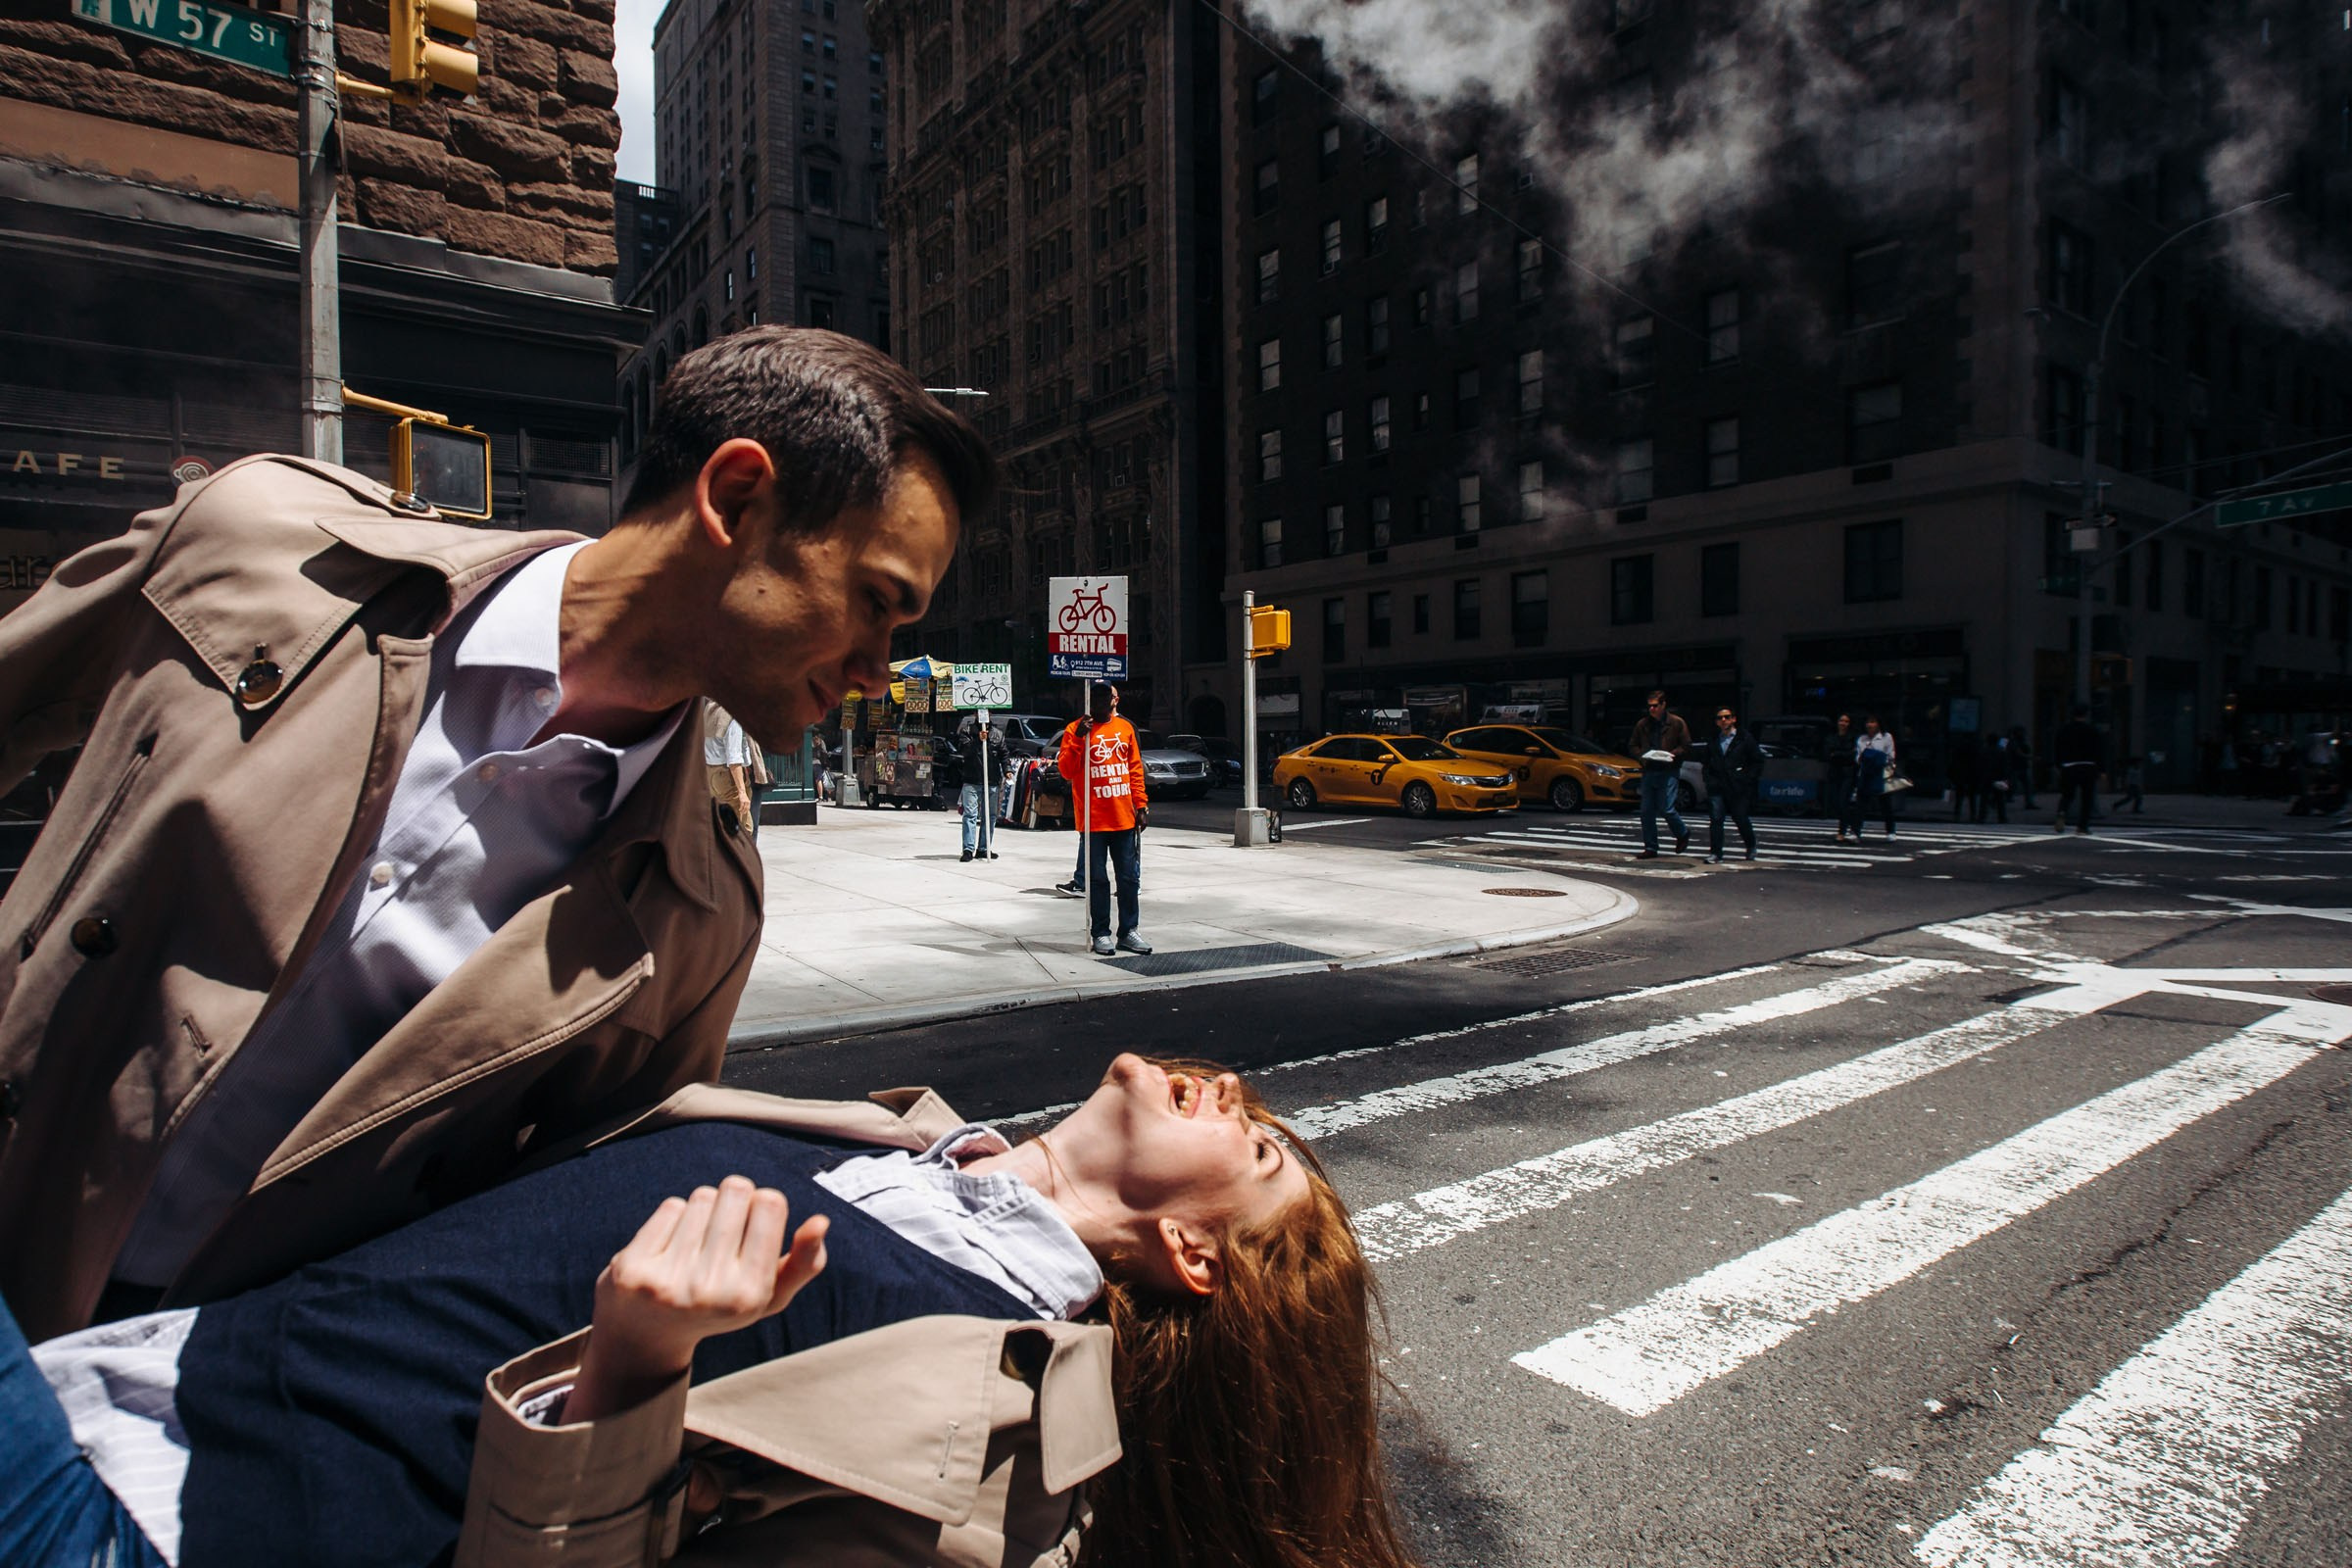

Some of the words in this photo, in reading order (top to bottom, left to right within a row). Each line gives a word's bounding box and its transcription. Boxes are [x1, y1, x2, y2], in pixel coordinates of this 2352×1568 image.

[127, 0, 160, 29] W
[178, 2, 232, 48] 57
[249, 22, 279, 46] ST
[2257, 500, 2272, 517] 7
[1058, 634, 1117, 654] RENTAL
[955, 664, 979, 674] BIKE
[981, 664, 1007, 673] RENT
[1090, 761, 1130, 778] RENTA
[1093, 782, 1131, 799] TOUR
